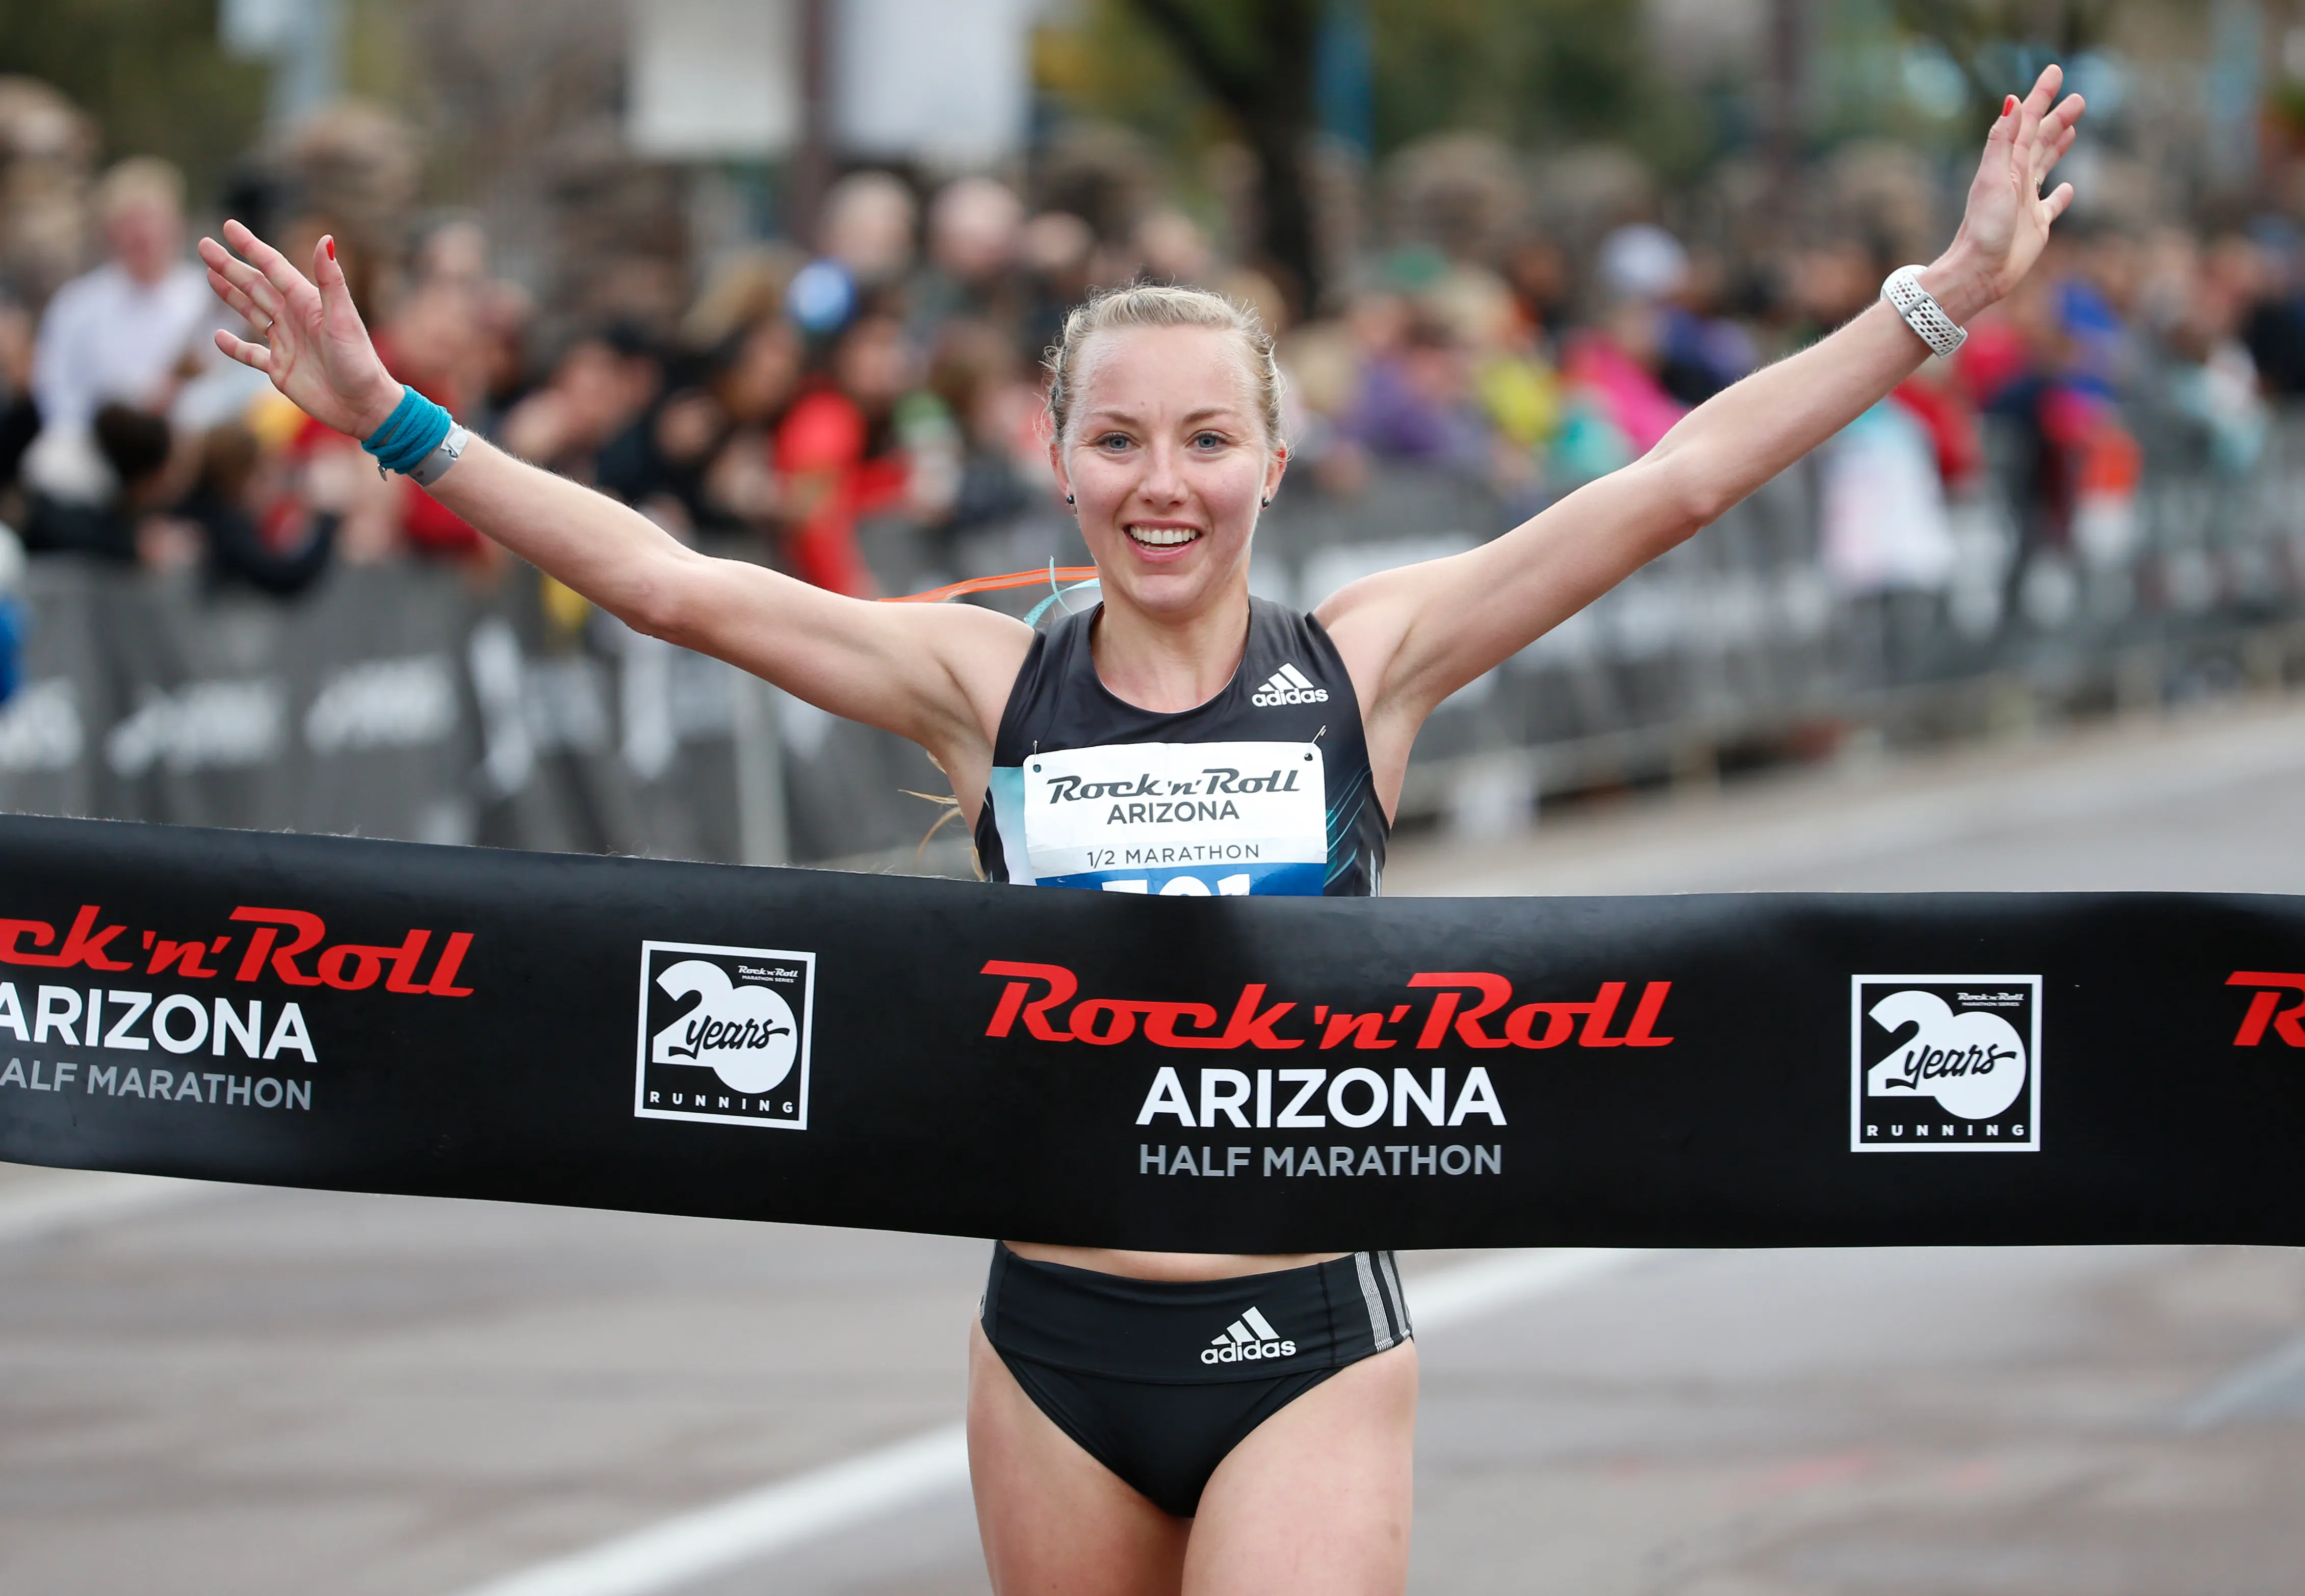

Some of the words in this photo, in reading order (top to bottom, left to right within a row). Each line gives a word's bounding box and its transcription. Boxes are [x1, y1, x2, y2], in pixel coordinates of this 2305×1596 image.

[1252, 688, 1329, 707] adidas
[1107, 800, 1240, 825] ARIZONA
[1087, 849, 1115, 869] 1/2
[1126, 844, 1259, 864] MARATHON
[0, 982, 318, 1063] ARIZONA
[668, 1015, 790, 1060] years
[1885, 1043, 2016, 1090] years
[87, 1064, 311, 1110] MARATHON
[1135, 1066, 1508, 1128] ARIZONA
[650, 1091, 793, 1113] RUNNING
[1867, 1124, 2024, 1136] RUNNING
[1140, 1144, 1251, 1177] HALF
[1263, 1144, 1501, 1177] MARATHON
[1201, 1340, 1297, 1364] adidas
